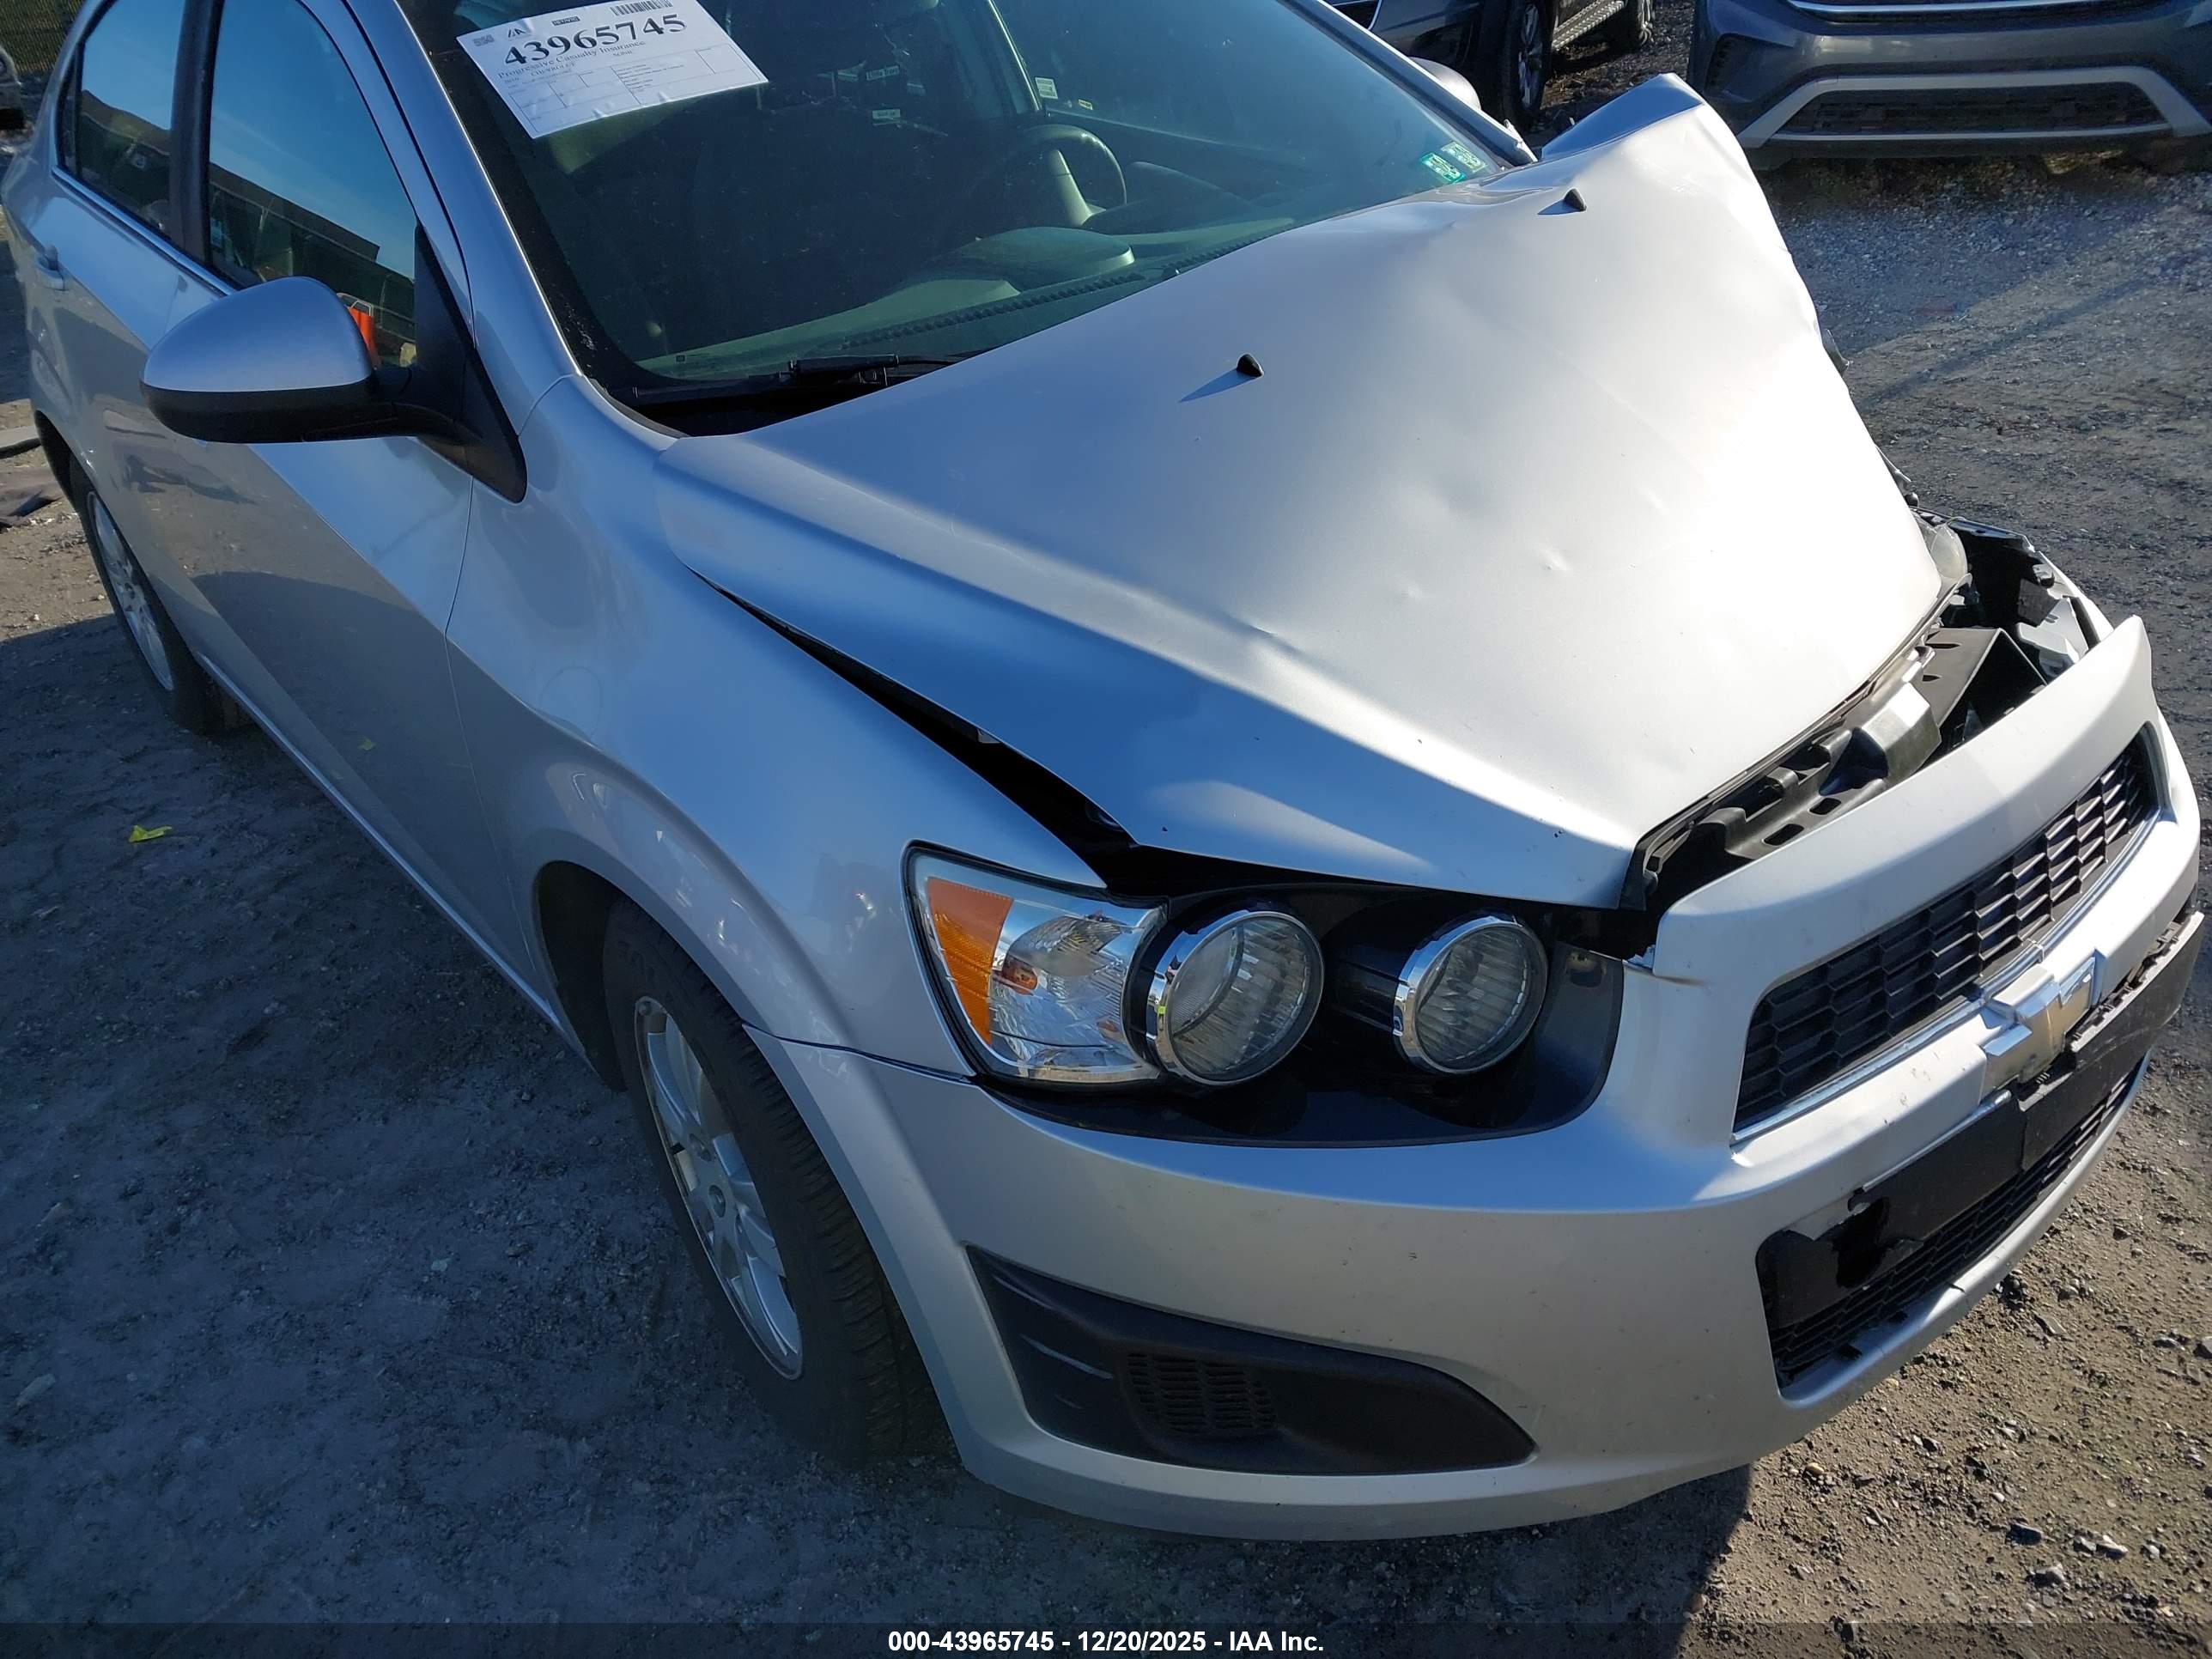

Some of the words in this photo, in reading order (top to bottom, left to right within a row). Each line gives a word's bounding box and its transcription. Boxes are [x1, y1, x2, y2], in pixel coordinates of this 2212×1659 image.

[497, 59, 555, 79] Progressive
[556, 50, 598, 64] Casualty
[599, 41, 646, 54] Insurance
[505, 14, 687, 64] 43965745
